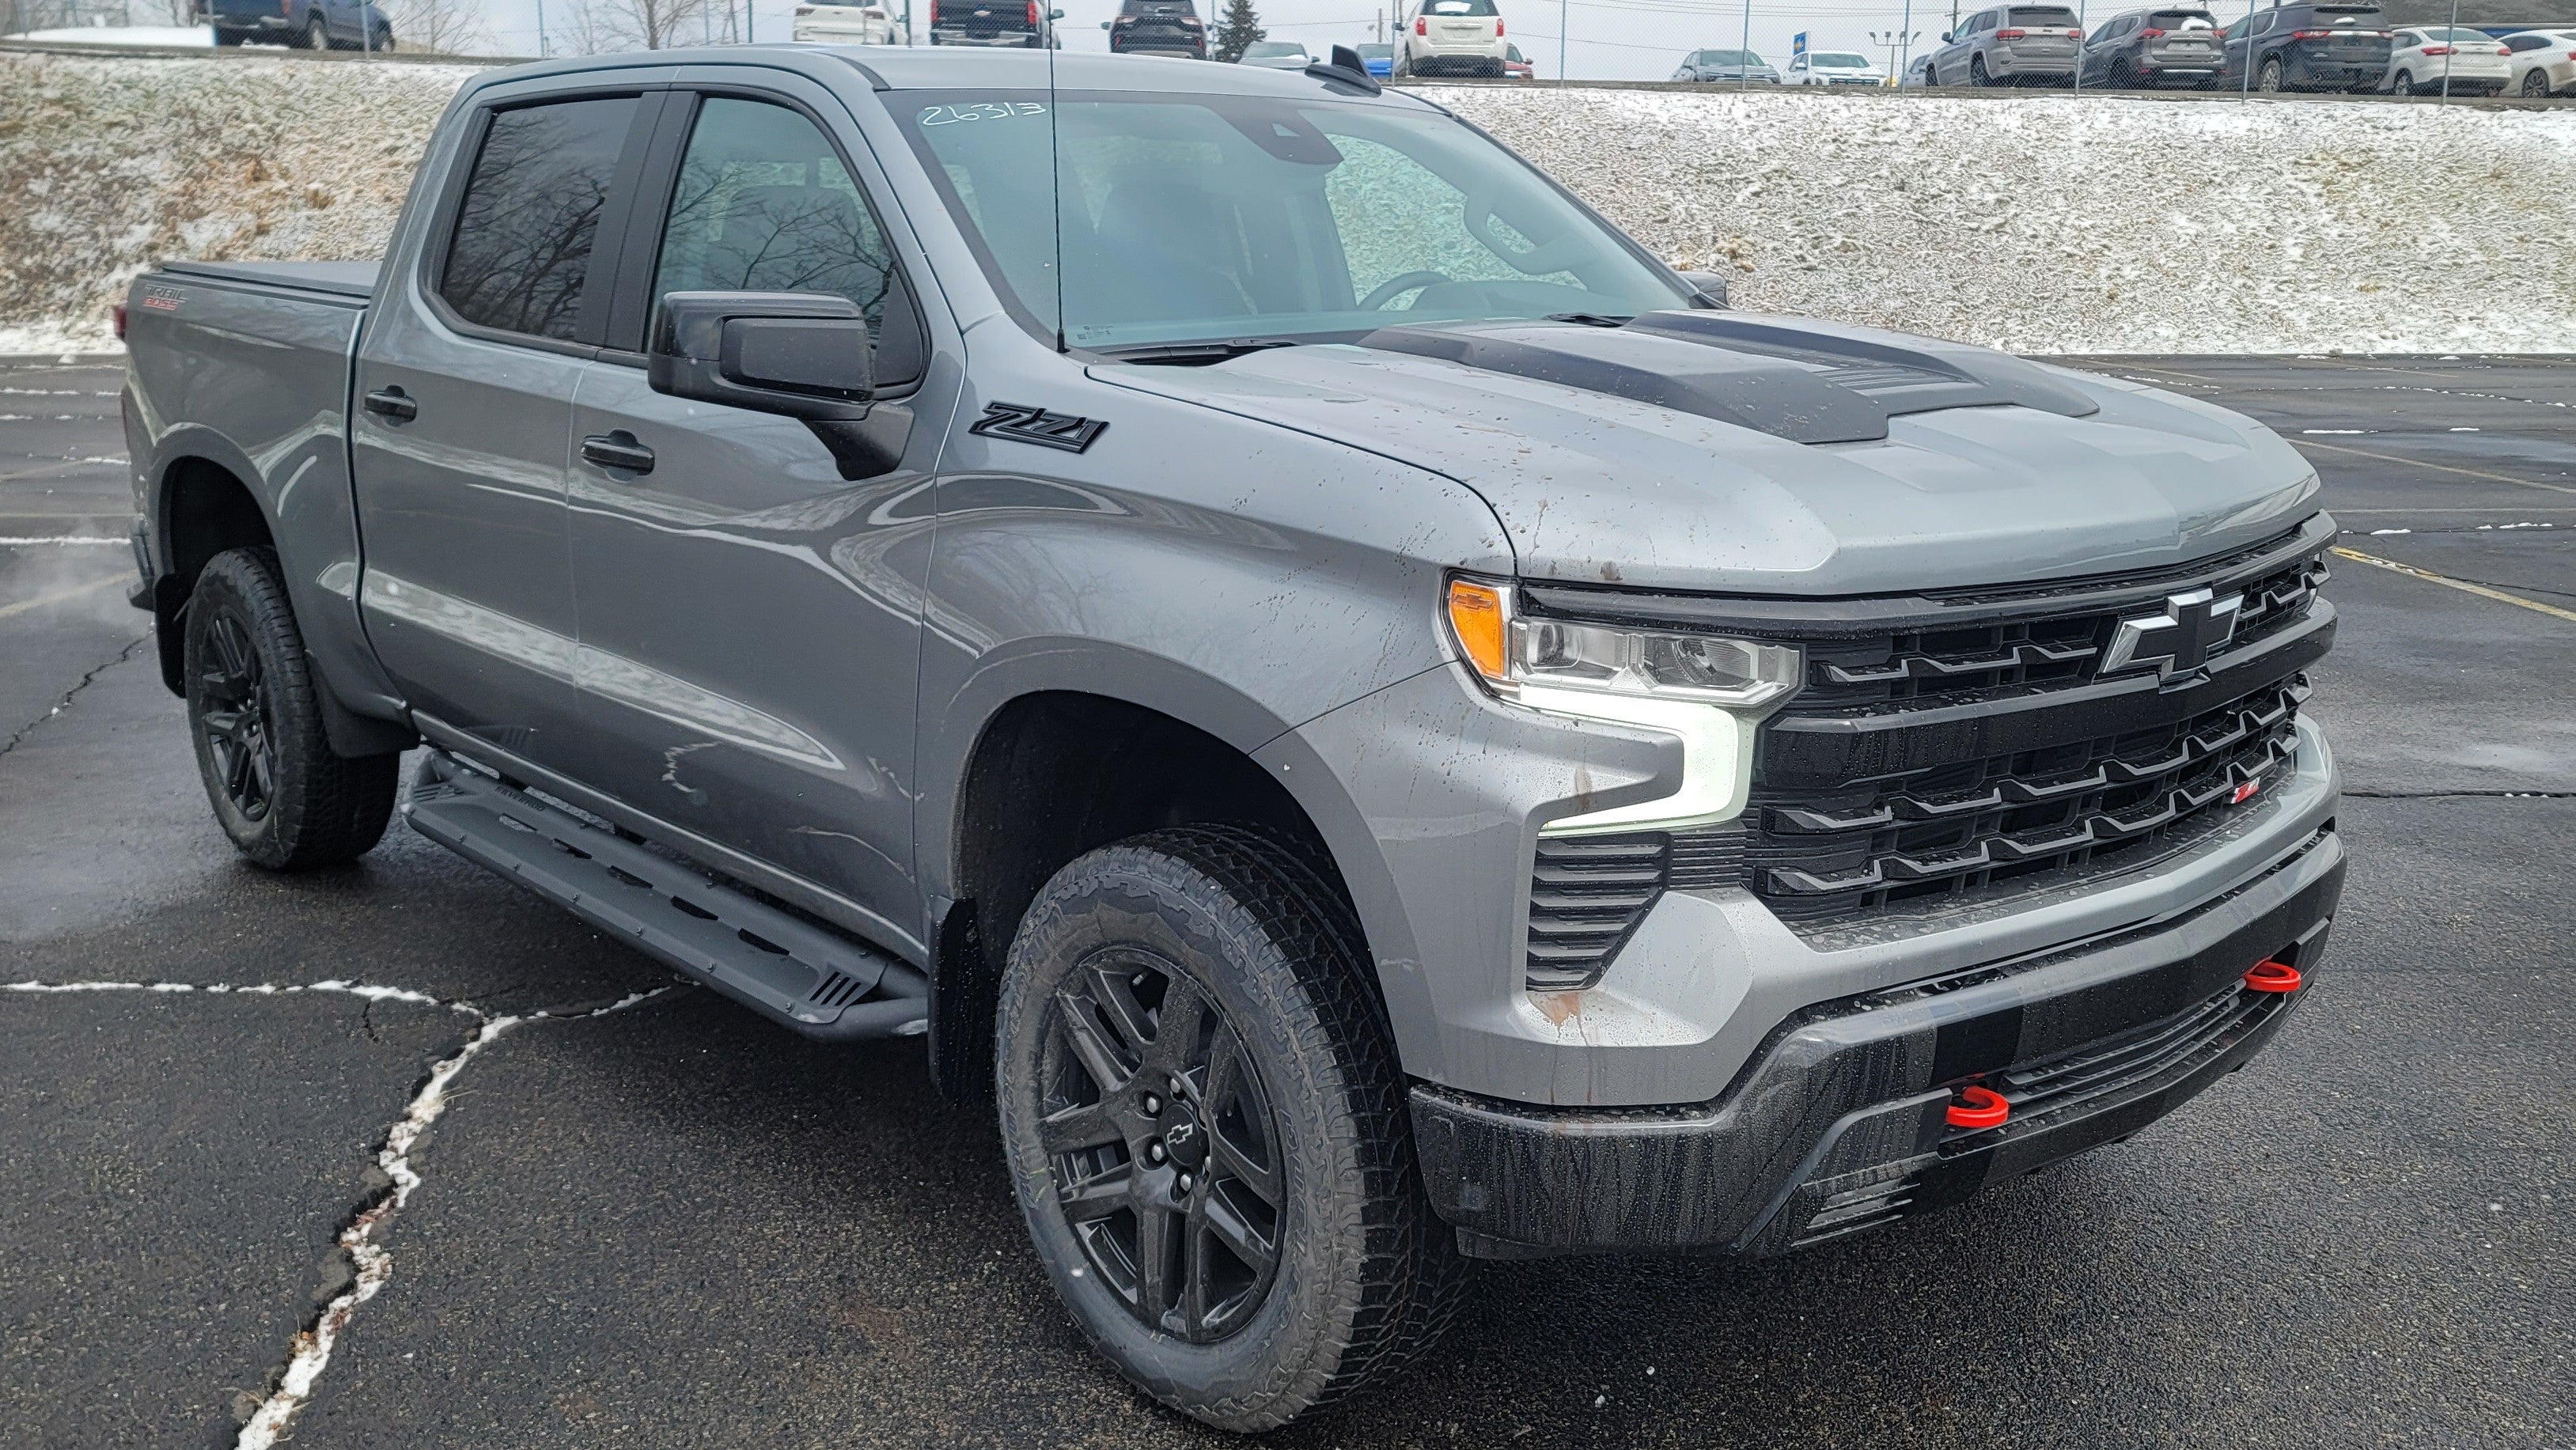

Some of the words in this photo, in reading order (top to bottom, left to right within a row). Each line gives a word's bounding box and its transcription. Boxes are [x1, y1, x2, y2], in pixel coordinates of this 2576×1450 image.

[922, 102, 1047, 126] 26313
[145, 285, 188, 302] TRAIL
[968, 400, 1111, 455] Z71
